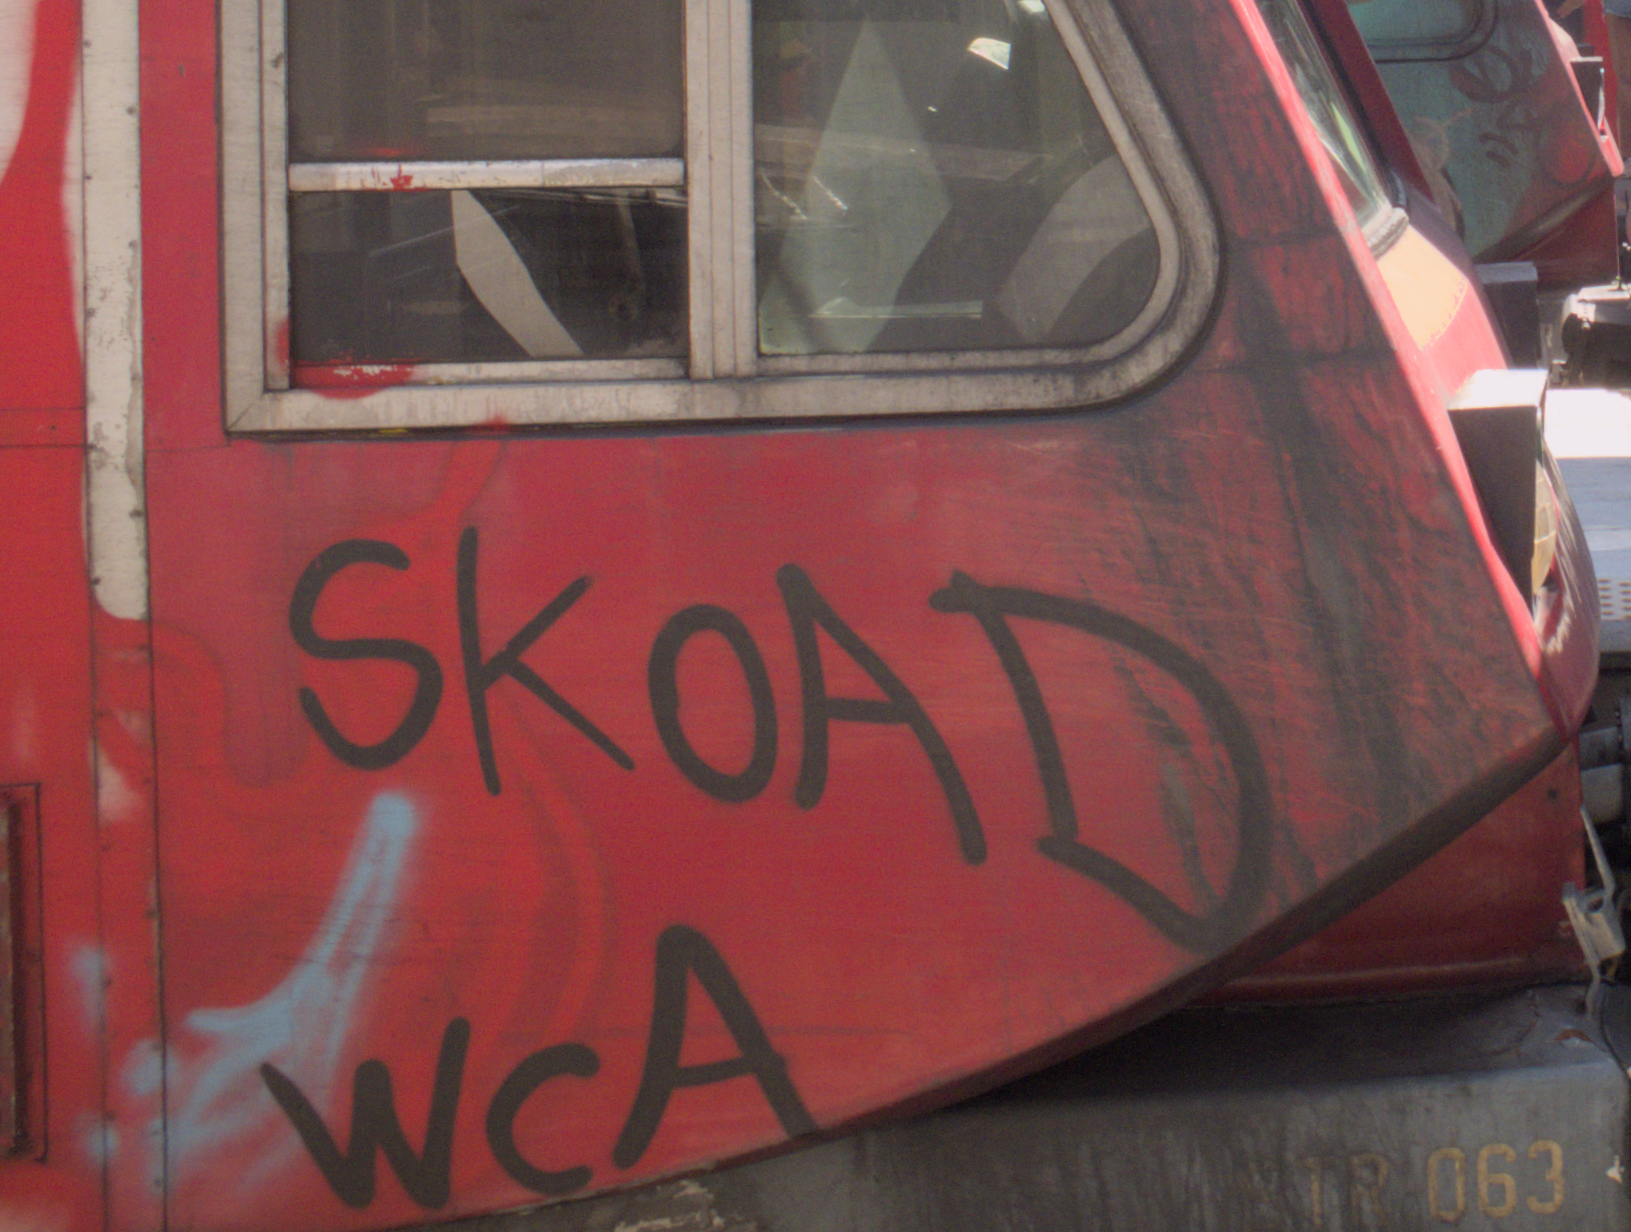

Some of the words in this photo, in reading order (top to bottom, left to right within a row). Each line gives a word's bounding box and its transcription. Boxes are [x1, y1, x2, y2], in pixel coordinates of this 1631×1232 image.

[287, 525, 1280, 960] SKOAD
[259, 924, 815, 1210] WCA
[1427, 1139, 1565, 1223] 063
